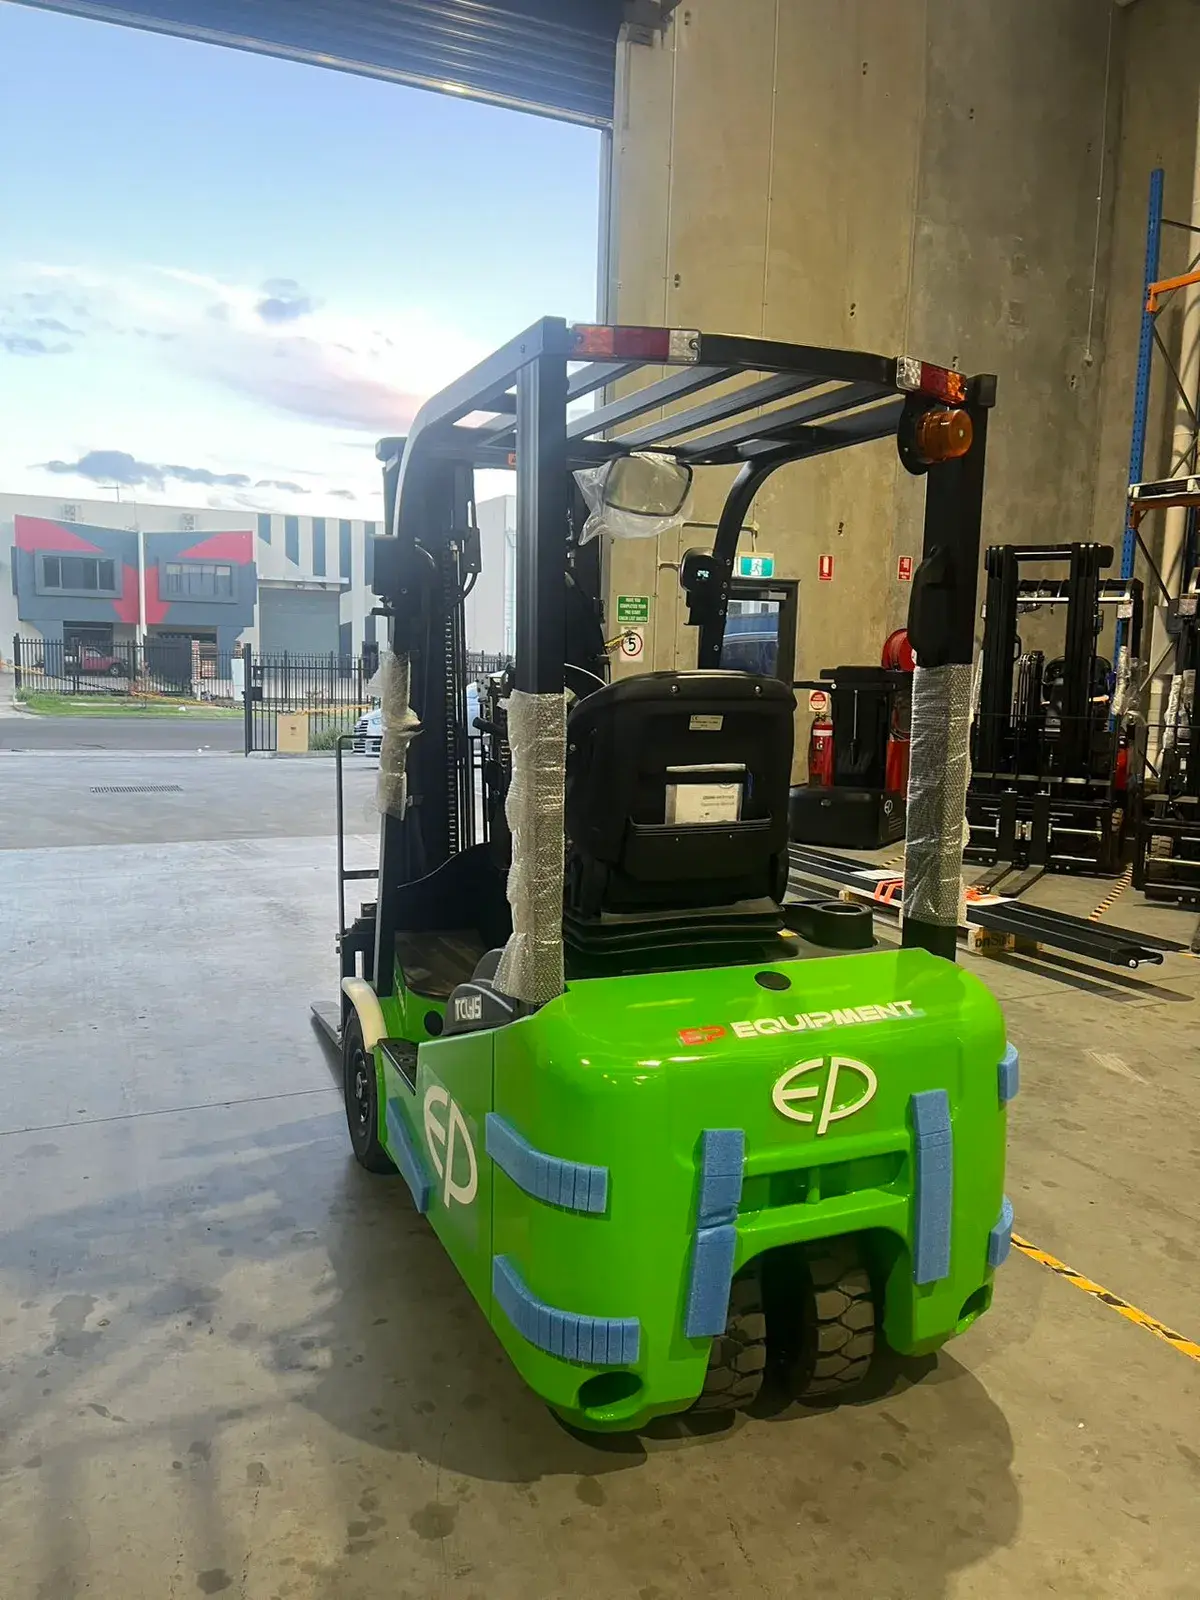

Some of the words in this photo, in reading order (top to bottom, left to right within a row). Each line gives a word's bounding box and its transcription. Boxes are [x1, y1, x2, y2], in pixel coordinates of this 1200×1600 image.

[628, 638, 636, 652] 5
[678, 1025, 726, 1046] EP
[730, 1000, 912, 1038] EQUIPMENT
[772, 1056, 878, 1134] EP
[424, 1085, 478, 1208] EP
